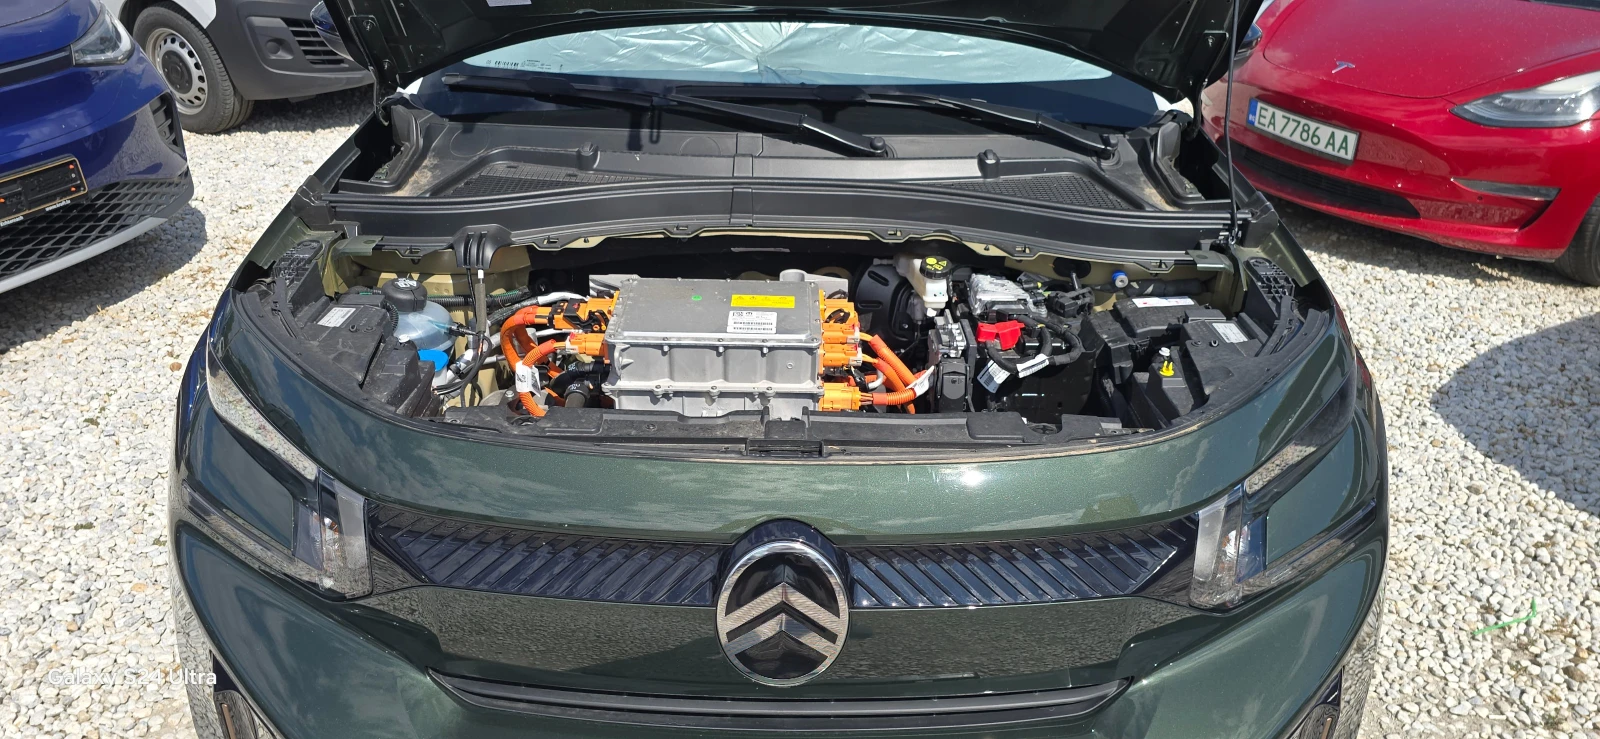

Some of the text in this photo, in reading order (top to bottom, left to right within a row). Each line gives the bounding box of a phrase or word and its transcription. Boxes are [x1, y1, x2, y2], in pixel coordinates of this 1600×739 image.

[1257, 106, 1349, 156] EA 7786 AA
